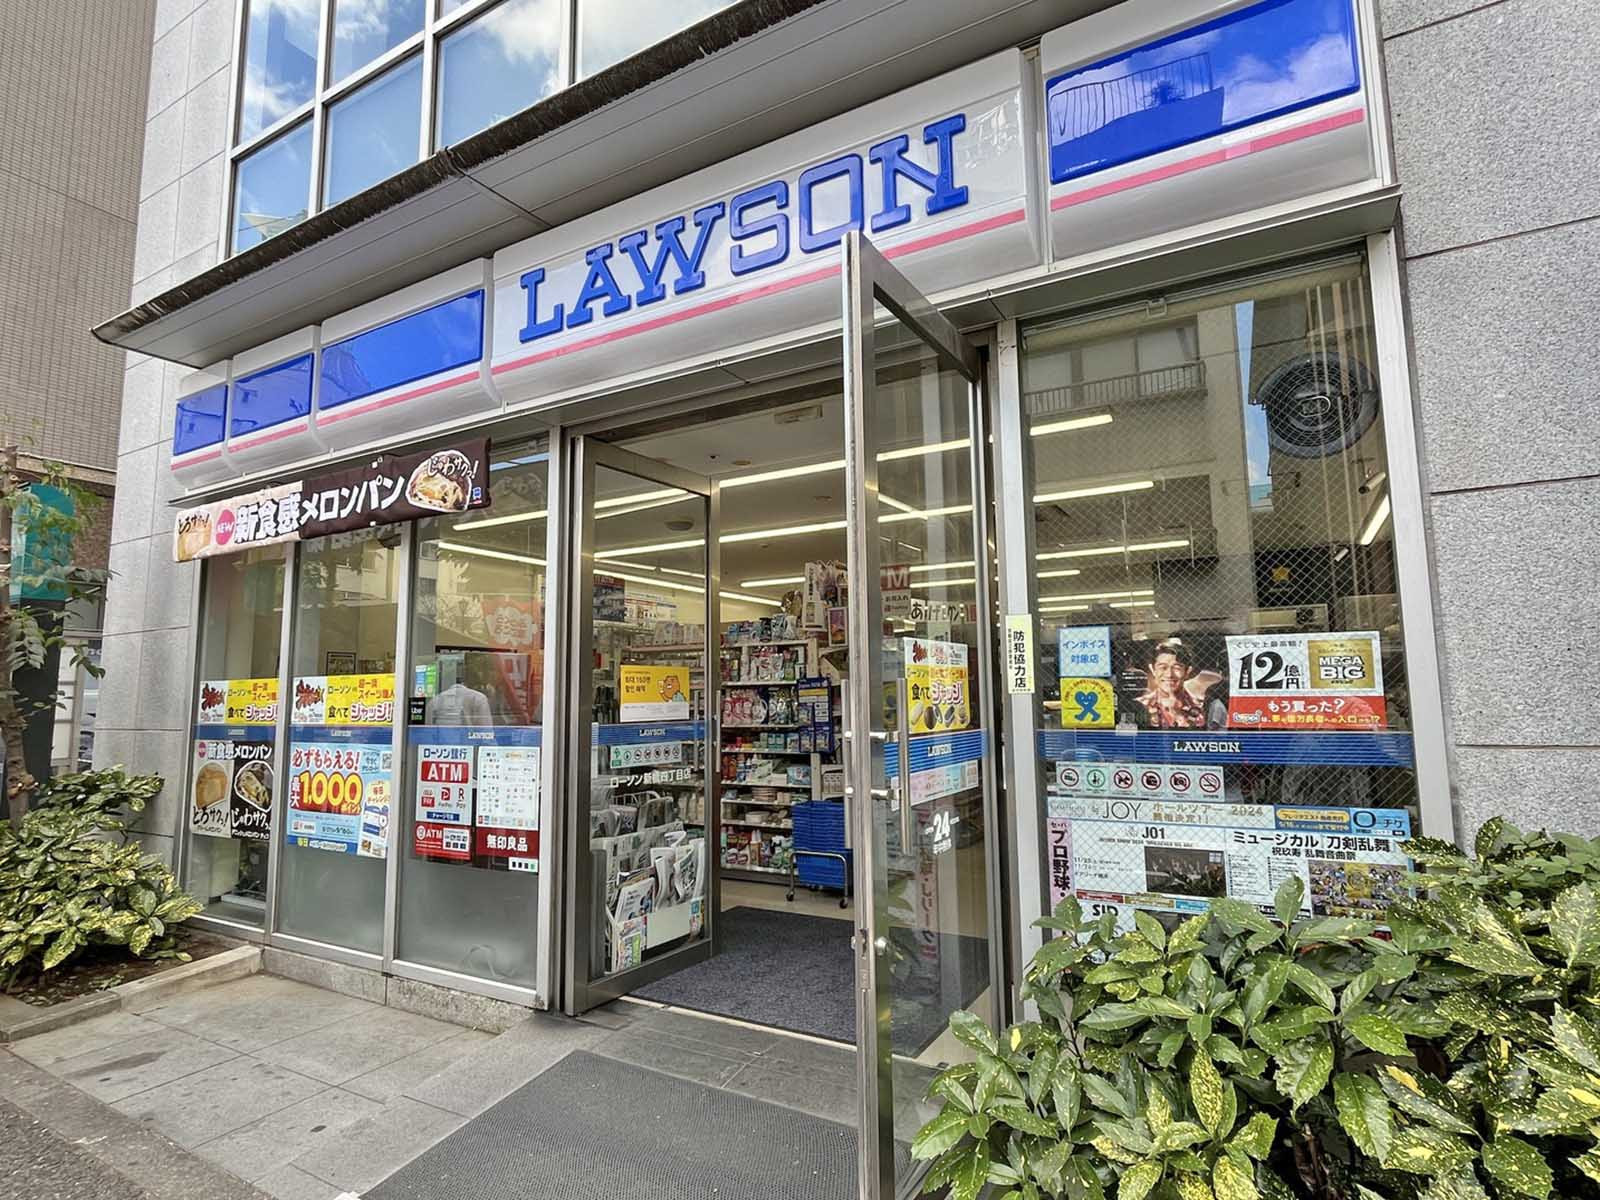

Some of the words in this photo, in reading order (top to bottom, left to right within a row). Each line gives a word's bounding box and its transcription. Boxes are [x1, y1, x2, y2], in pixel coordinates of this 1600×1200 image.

[519, 113, 969, 343] LAWSON
[235, 475, 405, 544] 新食感メロンパン
[1062, 640, 1106, 649] インボイス
[1013, 630, 1026, 688] 防犯協力店
[1071, 654, 1099, 664] 対象店
[1319, 655, 1364, 667] MEGA
[1239, 651, 1284, 689] 12
[1285, 664, 1301, 689] 億円
[1320, 666, 1365, 681] BIG
[1268, 699, 1345, 714] もう買った?
[423, 748, 467, 759] ローソン銀行
[1173, 741, 1240, 753] LAWSON
[292, 748, 360, 771] 必ずもらえる!
[427, 763, 463, 782] ATM
[1103, 801, 1142, 820] JOY
[1153, 803, 1225, 815] ホールツアー
[1231, 805, 1264, 817] 2024
[933, 811, 950, 842] 24
[426, 830, 442, 840] ATM
[487, 834, 528, 852] 無印良品
[1233, 831, 1319, 849] ミュージカル
[1327, 836, 1390, 853] 刀剣乱舞
